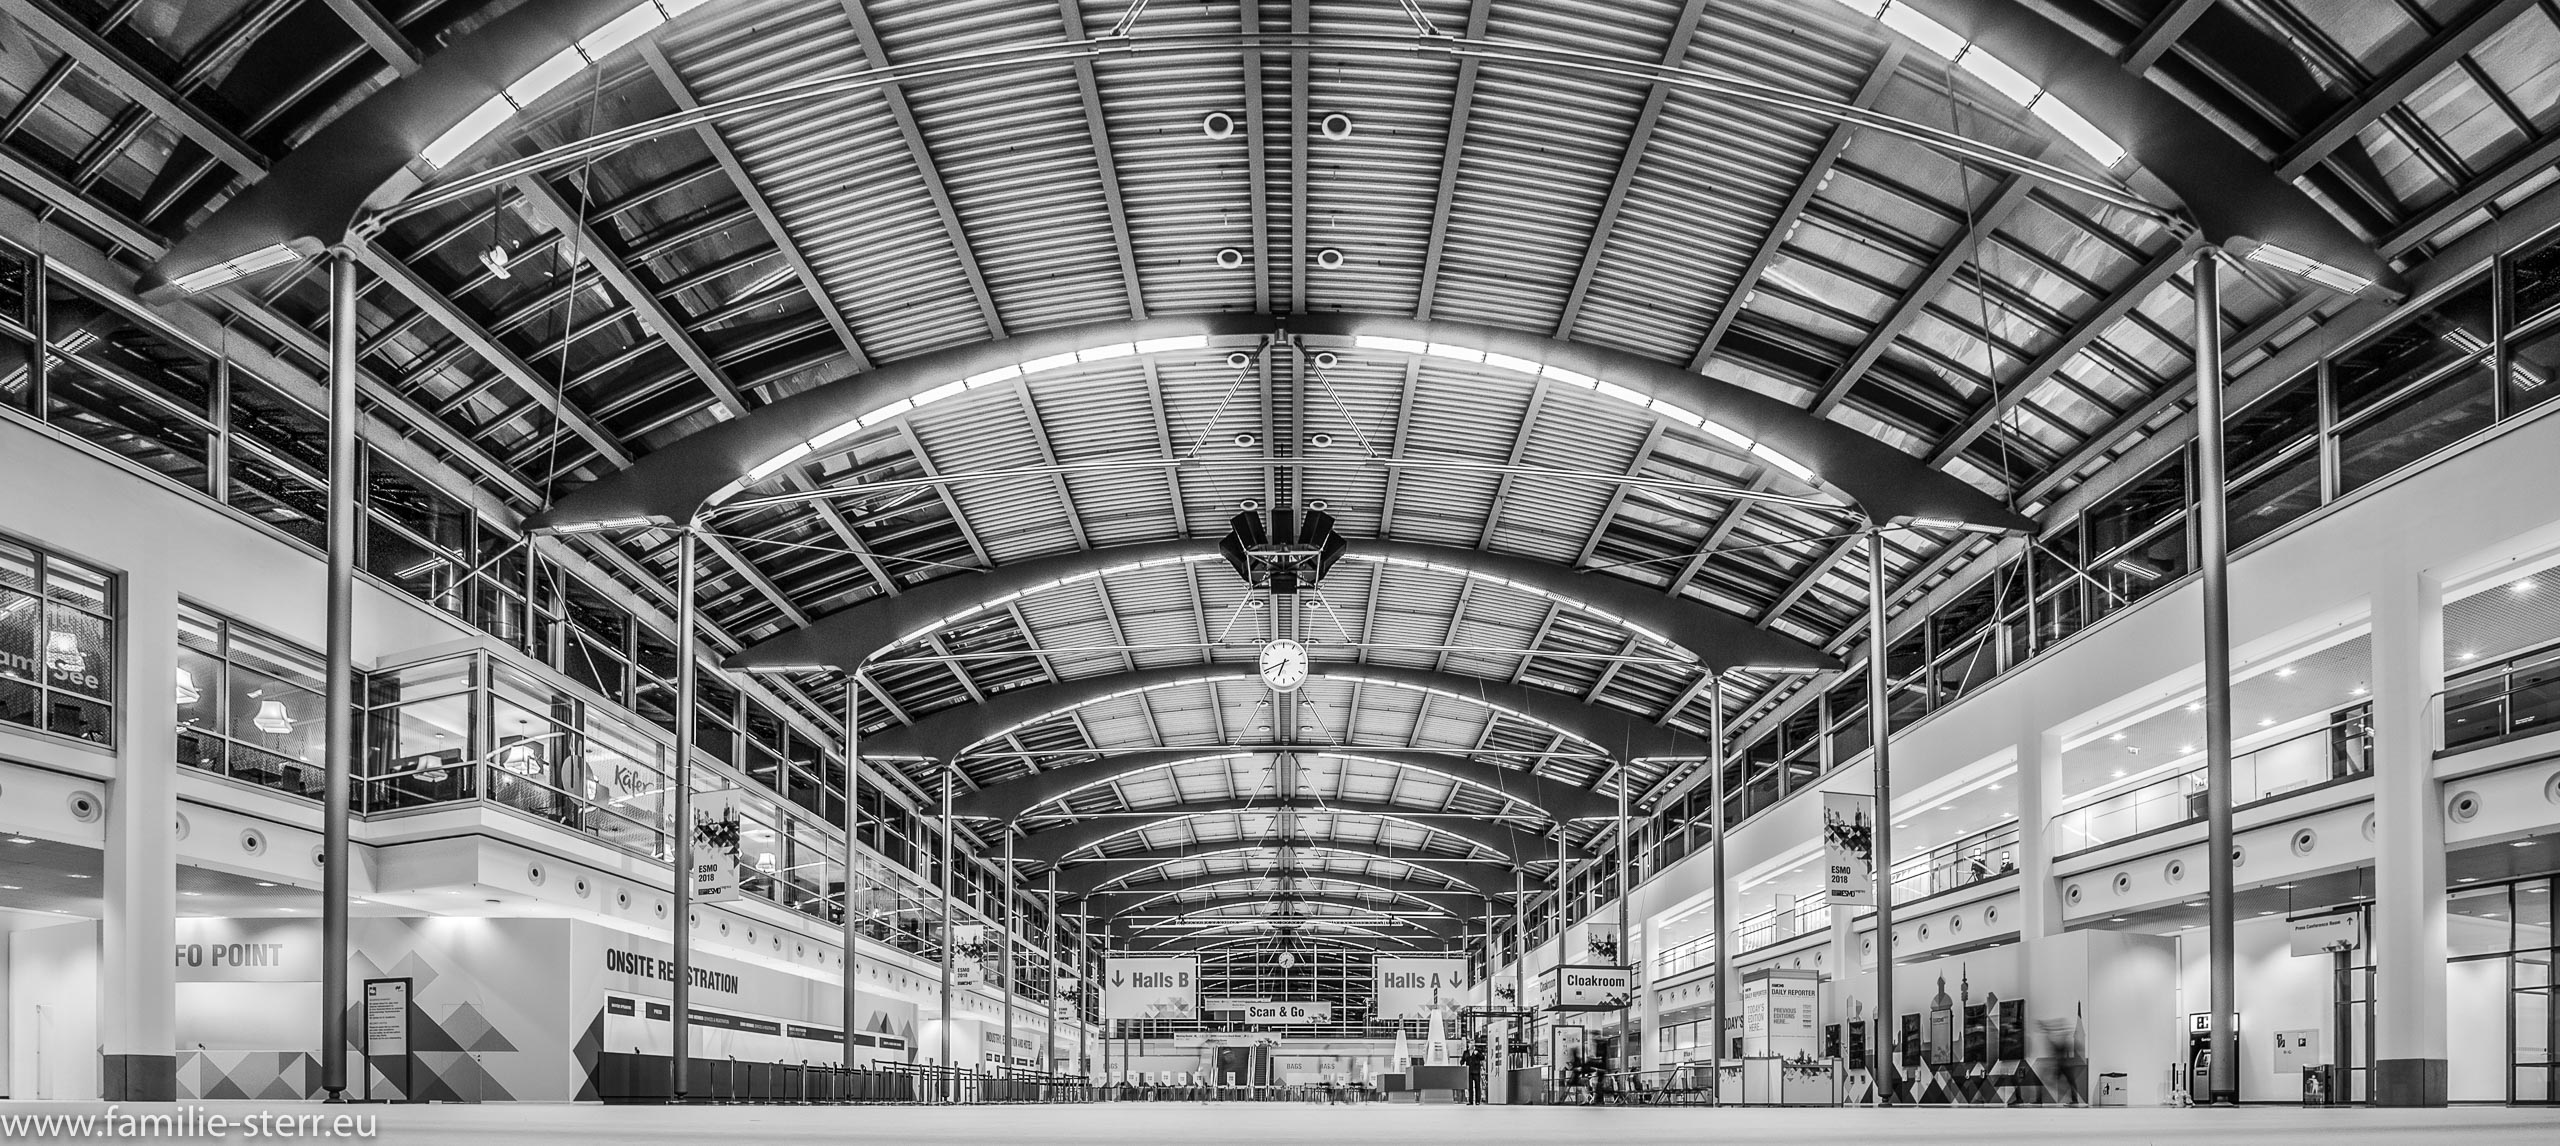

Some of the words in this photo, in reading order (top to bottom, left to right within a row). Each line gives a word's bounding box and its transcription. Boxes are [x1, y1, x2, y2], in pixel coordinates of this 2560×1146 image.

[54, 658, 99, 689] See
[615, 765, 655, 799] Käfer
[698, 864, 718, 873] ESMO
[1831, 866, 1851, 875] ESMO
[698, 873, 715, 883] 2018
[1831, 875, 1848, 884] 2018
[175, 944, 203, 967] FO
[212, 943, 283, 967] POINT
[606, 948, 654, 978] ONSITE
[658, 959, 739, 994] RESTRATION
[1132, 972, 1173, 988] Halls
[1178, 972, 1189, 988] B
[1384, 972, 1426, 989] Halls
[1430, 972, 1441, 989] A
[1567, 974, 1625, 987] Cloakroom
[1772, 988, 1786, 996] DAILY
[1787, 989, 1816, 997] REPORTER
[1249, 1006, 1276, 1018] Scan
[1279, 1006, 1287, 1018] &
[1290, 1006, 1305, 1018] Go
[1724, 1014, 1743, 1030] ODAY'S
